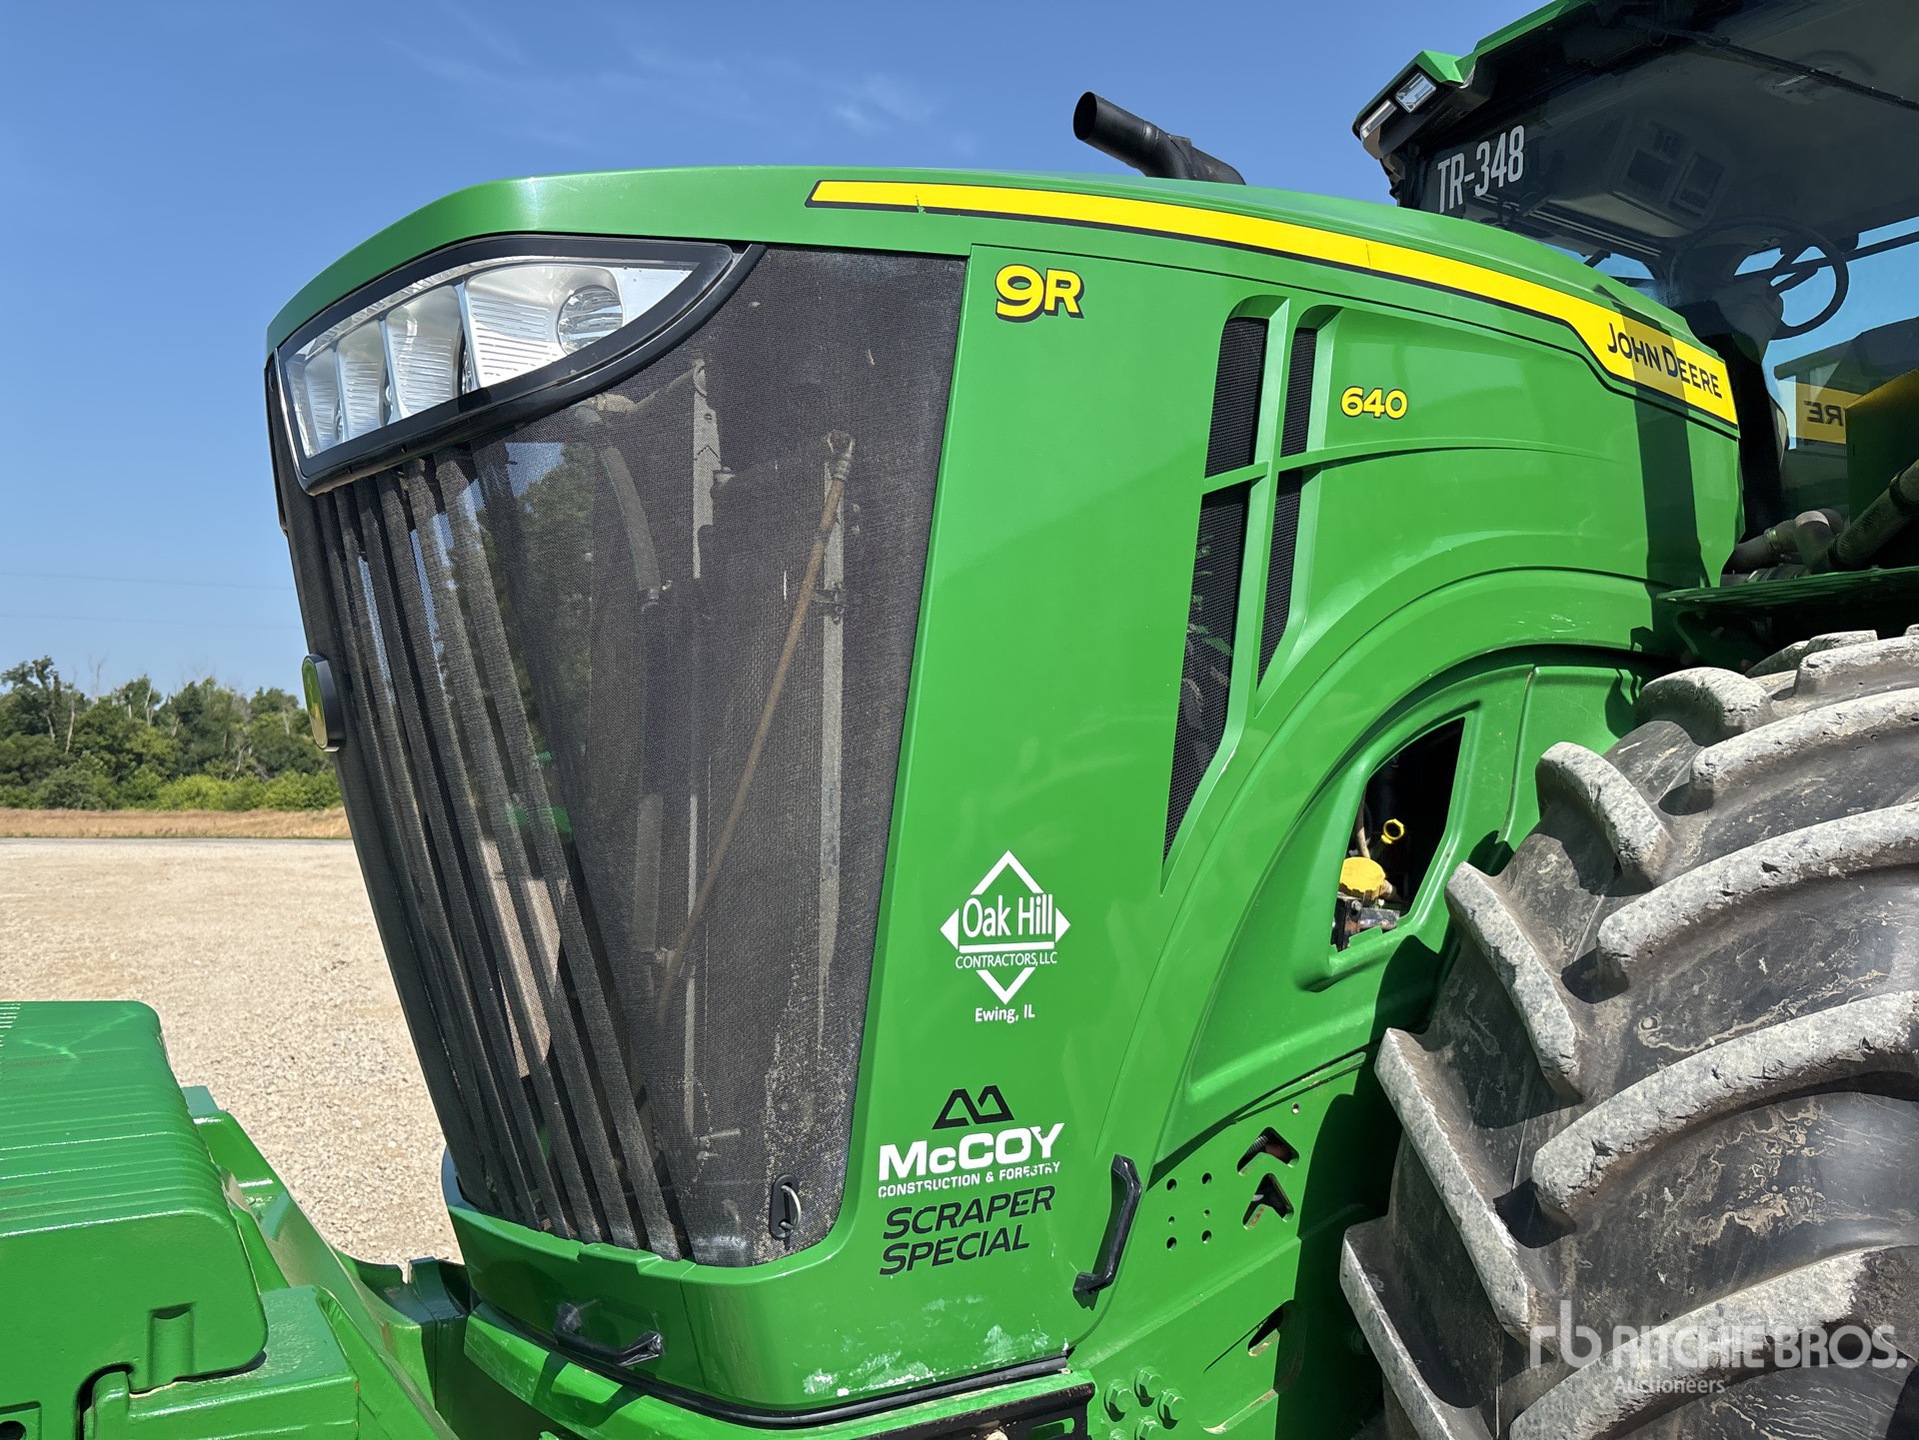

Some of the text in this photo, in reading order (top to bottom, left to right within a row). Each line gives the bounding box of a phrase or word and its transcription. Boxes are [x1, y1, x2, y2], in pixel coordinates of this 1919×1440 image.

[1437, 125, 1525, 213] TR-348
[995, 264, 1085, 323] 9R
[1607, 322, 1722, 399] JOHN DEERE
[1341, 385, 1408, 420] 640
[962, 893, 1054, 938] Oak Hill
[975, 1003, 1035, 1024] Ewing, IL
[878, 1122, 1065, 1181] McCOY
[877, 1161, 1061, 1198] CONSTRUCTION & FORESTRY
[882, 1185, 1056, 1240] SCRAPER
[879, 1224, 1030, 1276] SPECIAL
